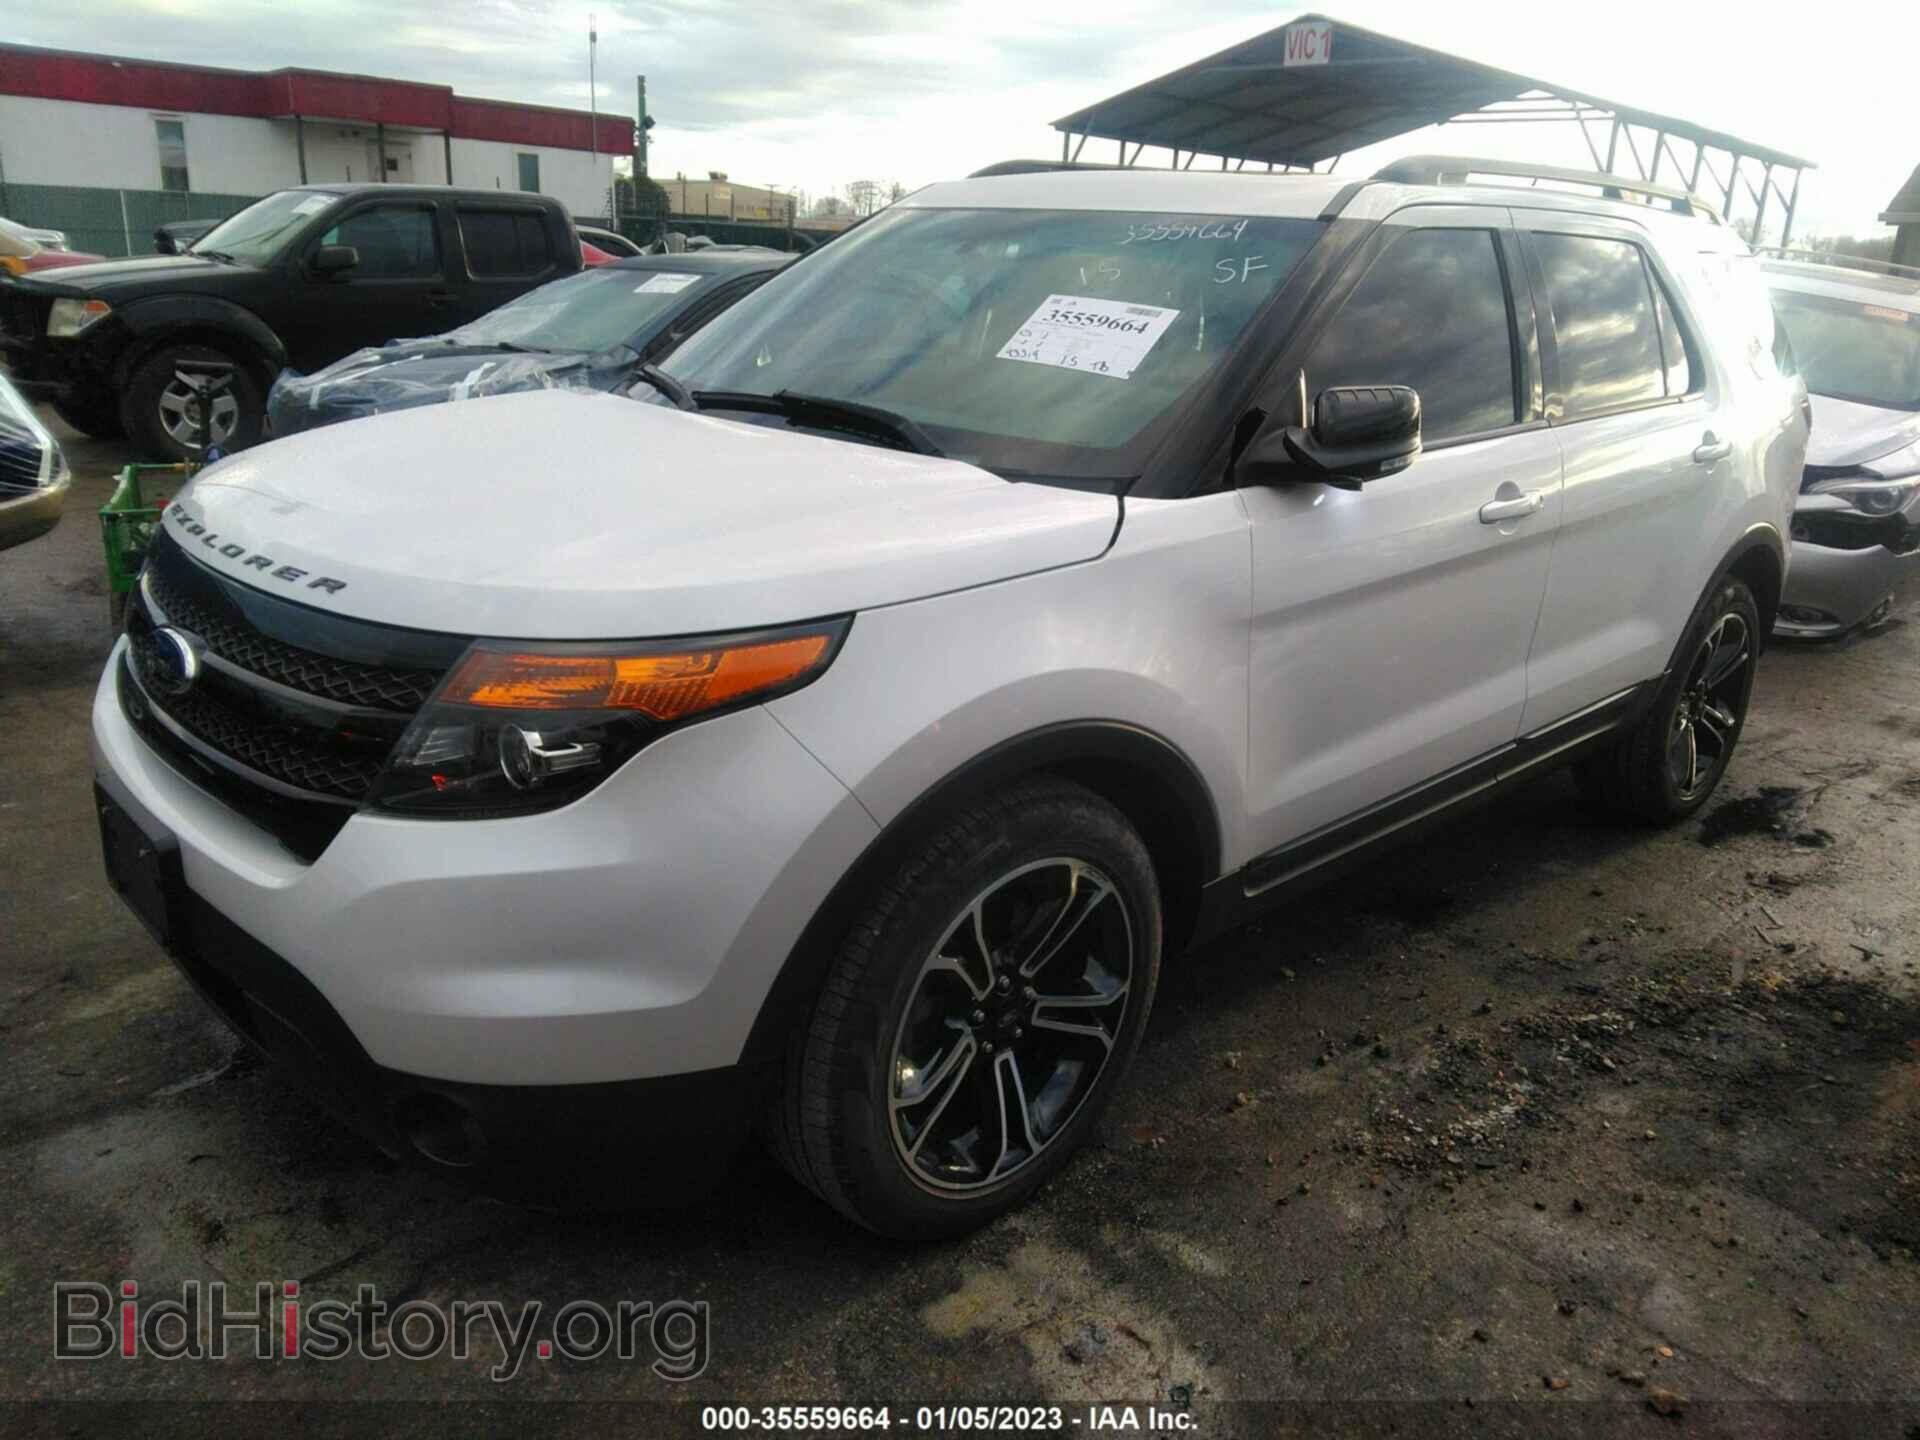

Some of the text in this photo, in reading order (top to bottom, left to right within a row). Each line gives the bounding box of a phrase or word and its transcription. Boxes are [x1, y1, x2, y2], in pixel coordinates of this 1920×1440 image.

[1288, 26, 1330, 59] VIC 1
[1213, 256, 1269, 283] SF
[1042, 309, 1151, 335] 35559664
[169, 503, 348, 595] EXPLORER
